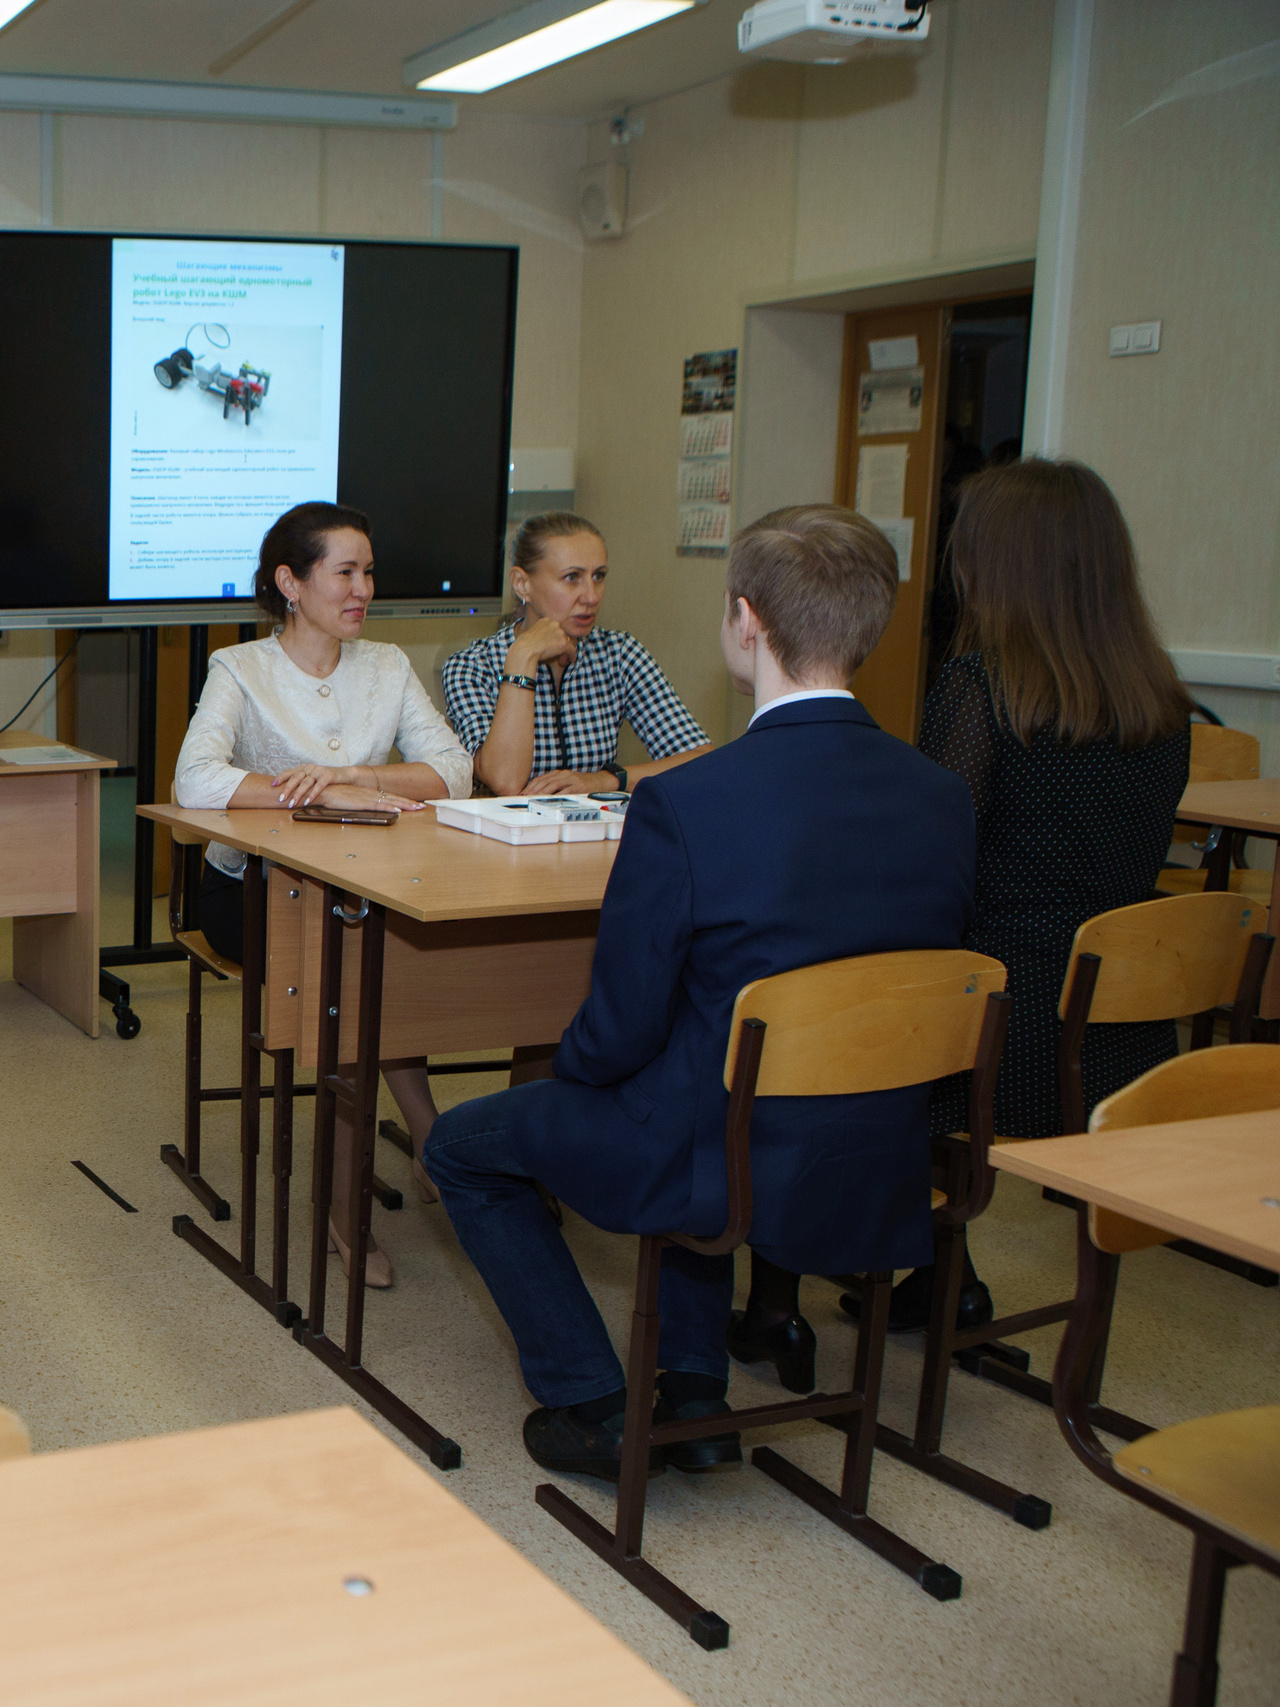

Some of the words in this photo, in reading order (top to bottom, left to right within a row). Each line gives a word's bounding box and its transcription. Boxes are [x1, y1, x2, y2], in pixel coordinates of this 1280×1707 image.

[177, 261, 228, 271] Шагающие
[230, 263, 283, 272] механизмы
[132, 273, 178, 283] Учебный
[180, 275, 236, 285] шагающий
[238, 277, 312, 287] одномоторный
[132, 288, 162, 298] робот
[165, 289, 187, 299] Lego
[189, 289, 206, 298] EV3
[222, 289, 247, 299] КШМ
